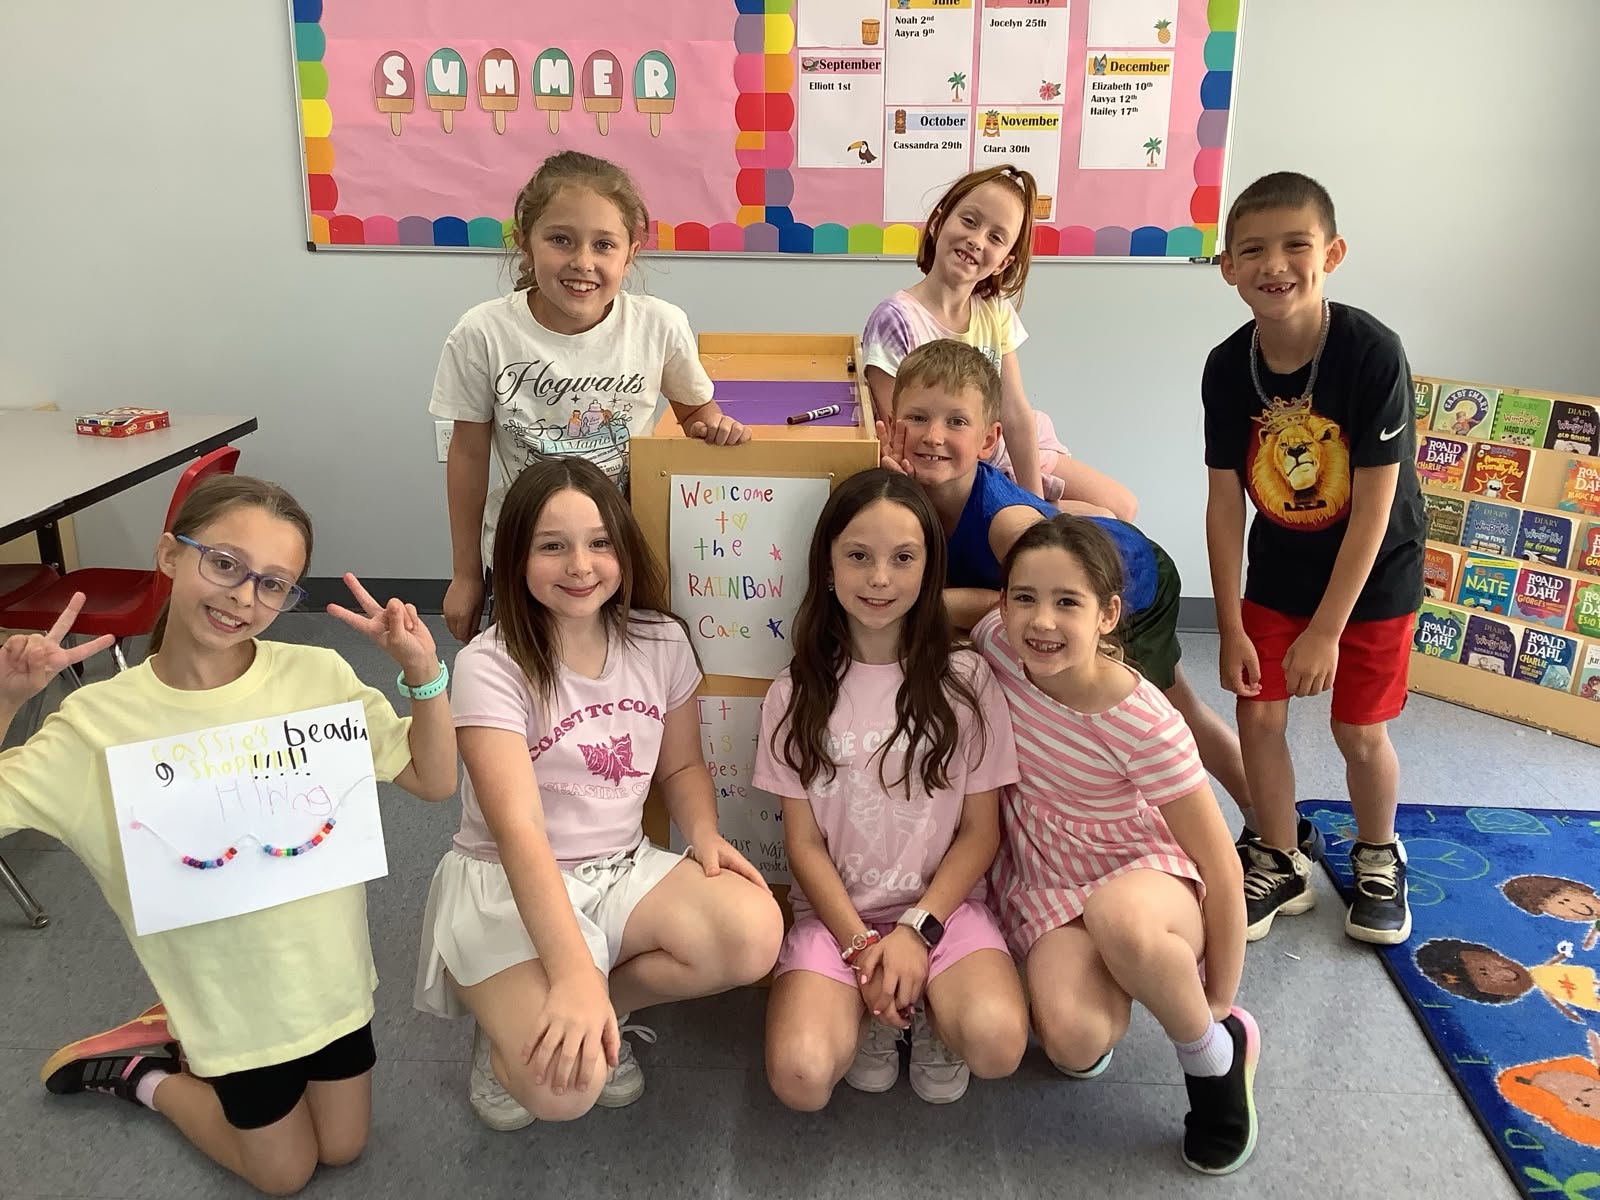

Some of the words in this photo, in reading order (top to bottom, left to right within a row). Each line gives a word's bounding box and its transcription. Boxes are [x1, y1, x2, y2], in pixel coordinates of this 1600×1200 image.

[895, 16, 918, 25] Noah
[920, 15, 935, 25] 2nd
[989, 19, 1023, 29] Jocelyn
[1025, 19, 1047, 28] 25th
[894, 28, 920, 39] Aayra
[922, 28, 935, 38] 9th
[819, 59, 882, 72] September
[1110, 61, 1170, 73] December
[383, 55, 670, 99] SUMMER
[809, 82, 837, 91] Elliott
[838, 82, 851, 91] 1st
[1092, 82, 1132, 91] Elizabeth
[1135, 81, 1153, 91] 10th
[1090, 95, 1116, 104] Aavya
[1119, 94, 1138, 104] 12th
[1090, 107, 1118, 117] Hailey
[1120, 106, 1139, 116] 17th
[920, 115, 966, 127] October
[1001, 115, 1059, 127] November
[893, 141, 939, 150] Cassandra
[941, 140, 963, 150] 29th
[983, 144, 1007, 154] Clara
[1009, 144, 1031, 154] 30th
[495, 360, 647, 406] Hogwarts
[566, 435, 611, 450] Magic
[1428, 440, 1462, 454] ROALD
[1426, 451, 1459, 466] DAHL
[680, 481, 774, 509] Wellcome
[1534, 516, 1559, 527] DIARY
[694, 538, 742, 561] the
[688, 573, 784, 601] RAINBOW
[1465, 575, 1511, 597] NATE
[1527, 573, 1564, 590] ROALD
[1524, 584, 1561, 603] DAHL
[698, 615, 751, 639] Cafe
[1422, 621, 1457, 638] ROALD
[1420, 630, 1454, 650] DAHL
[1527, 631, 1566, 650] ROALD
[1424, 644, 1444, 656] BOY
[1525, 642, 1563, 663] DAHL
[1519, 654, 1549, 668] CHARLIE
[529, 710, 584, 762] COAST
[708, 735, 733, 755] is
